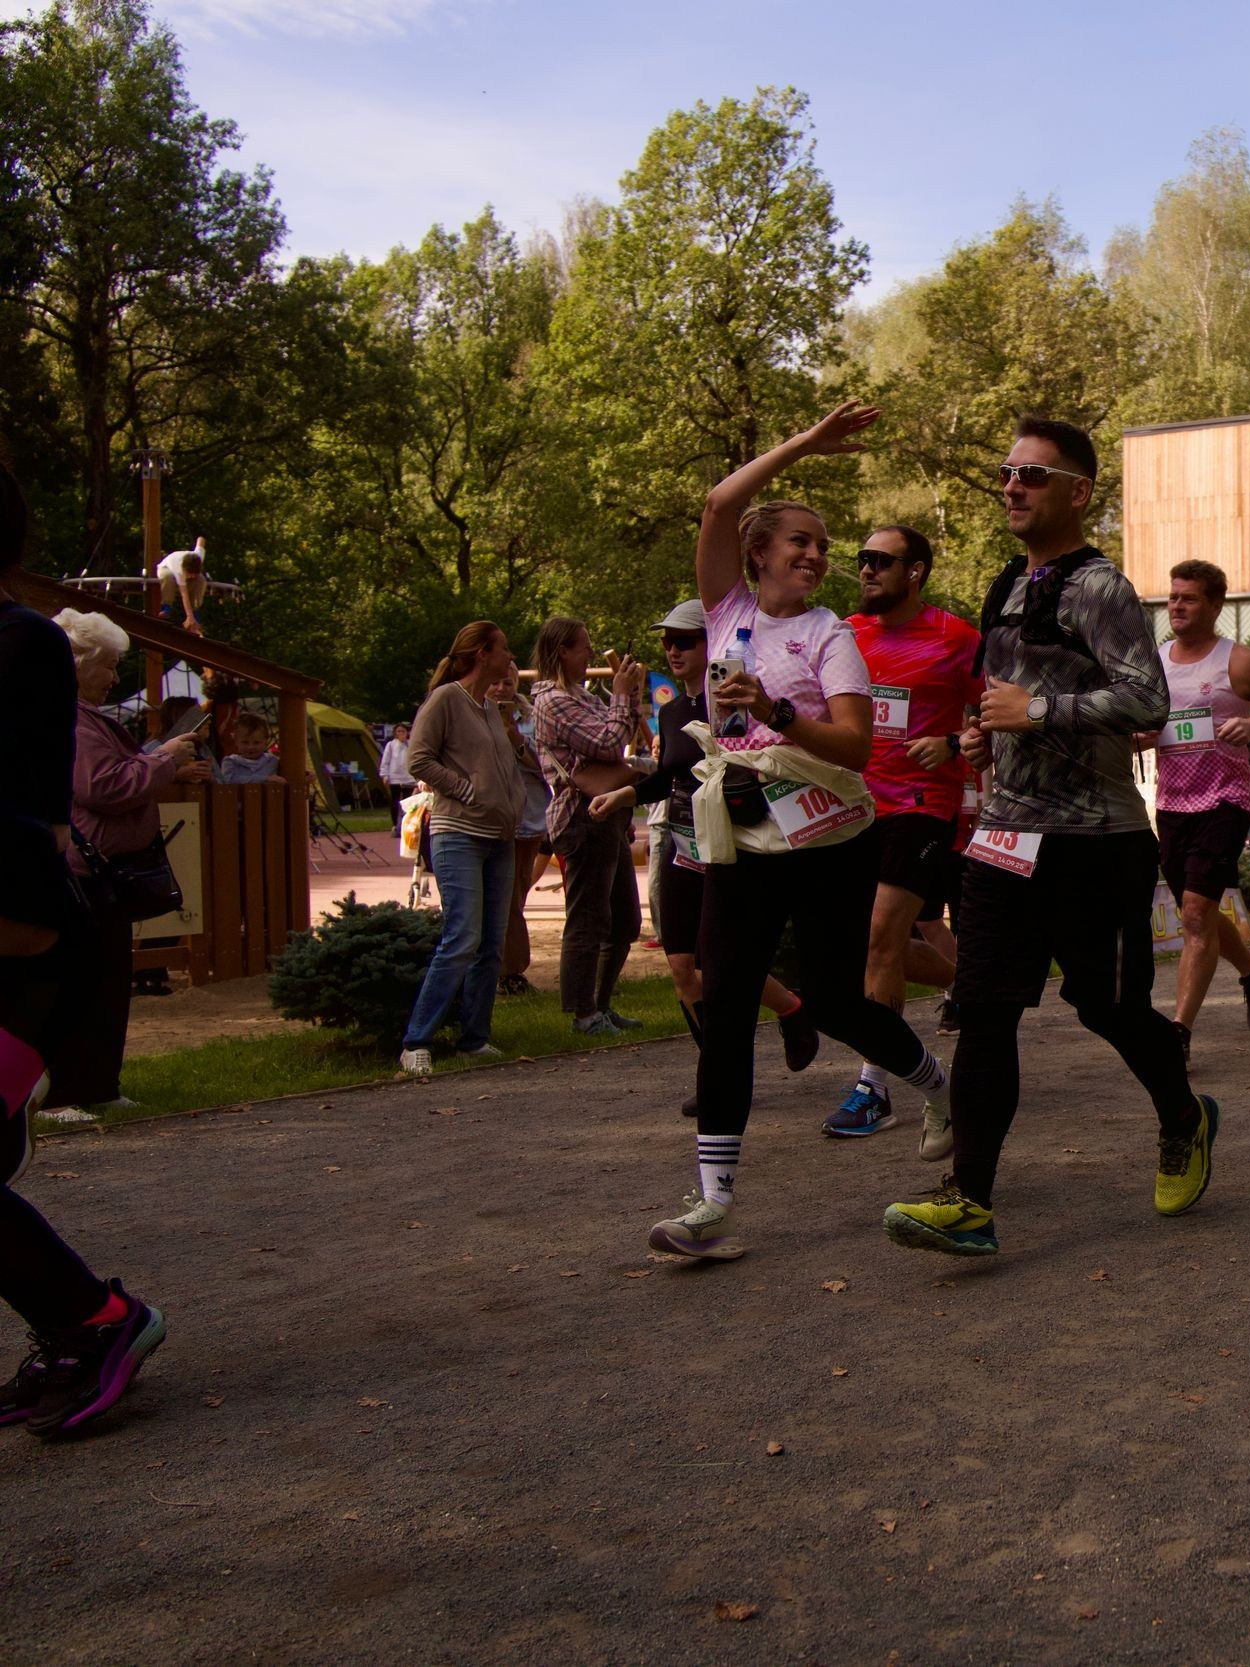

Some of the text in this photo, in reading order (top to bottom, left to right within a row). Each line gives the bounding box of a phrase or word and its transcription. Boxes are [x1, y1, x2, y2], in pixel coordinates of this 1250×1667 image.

[878, 690, 903, 698] ДУБКИ
[1184, 711, 1206, 719] ДУБКИ
[1175, 722, 1194, 741] 19
[986, 831, 1020, 851] 103
